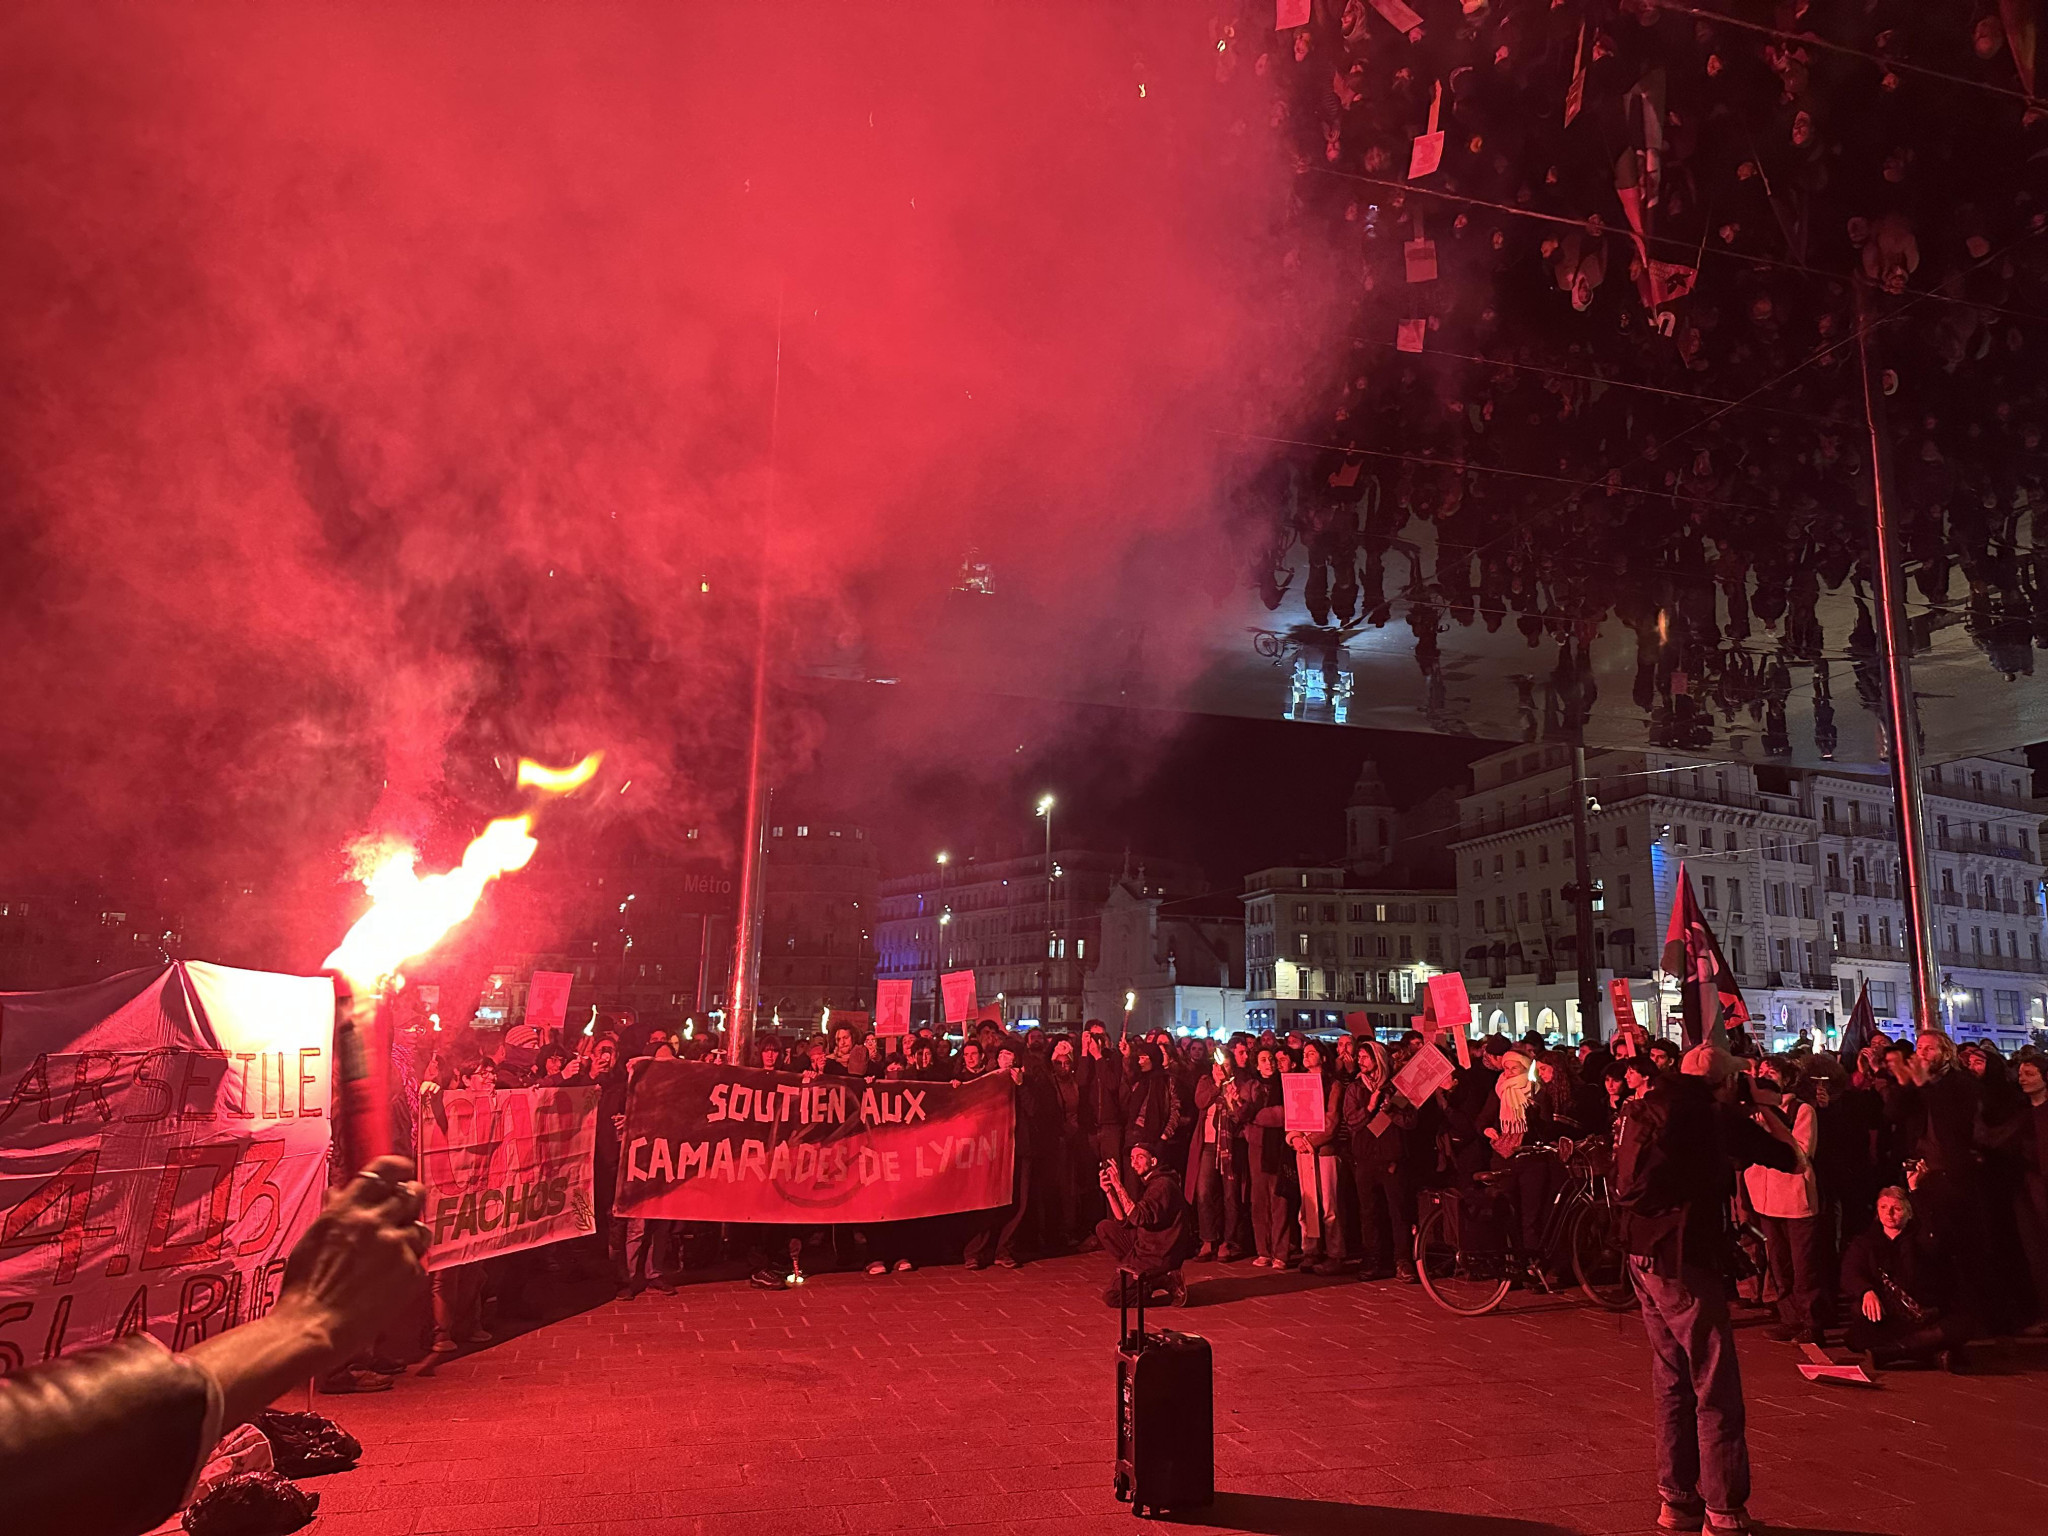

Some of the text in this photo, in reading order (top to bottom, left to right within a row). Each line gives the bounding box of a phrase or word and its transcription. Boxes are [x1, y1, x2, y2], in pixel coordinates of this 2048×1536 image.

[684, 874, 731, 894] Métro
[707, 1083, 926, 1125] SOUTIEN AUX
[627, 1129, 998, 1187] CAMARADES DE LYON
[433, 1177, 570, 1246] FACHOS
